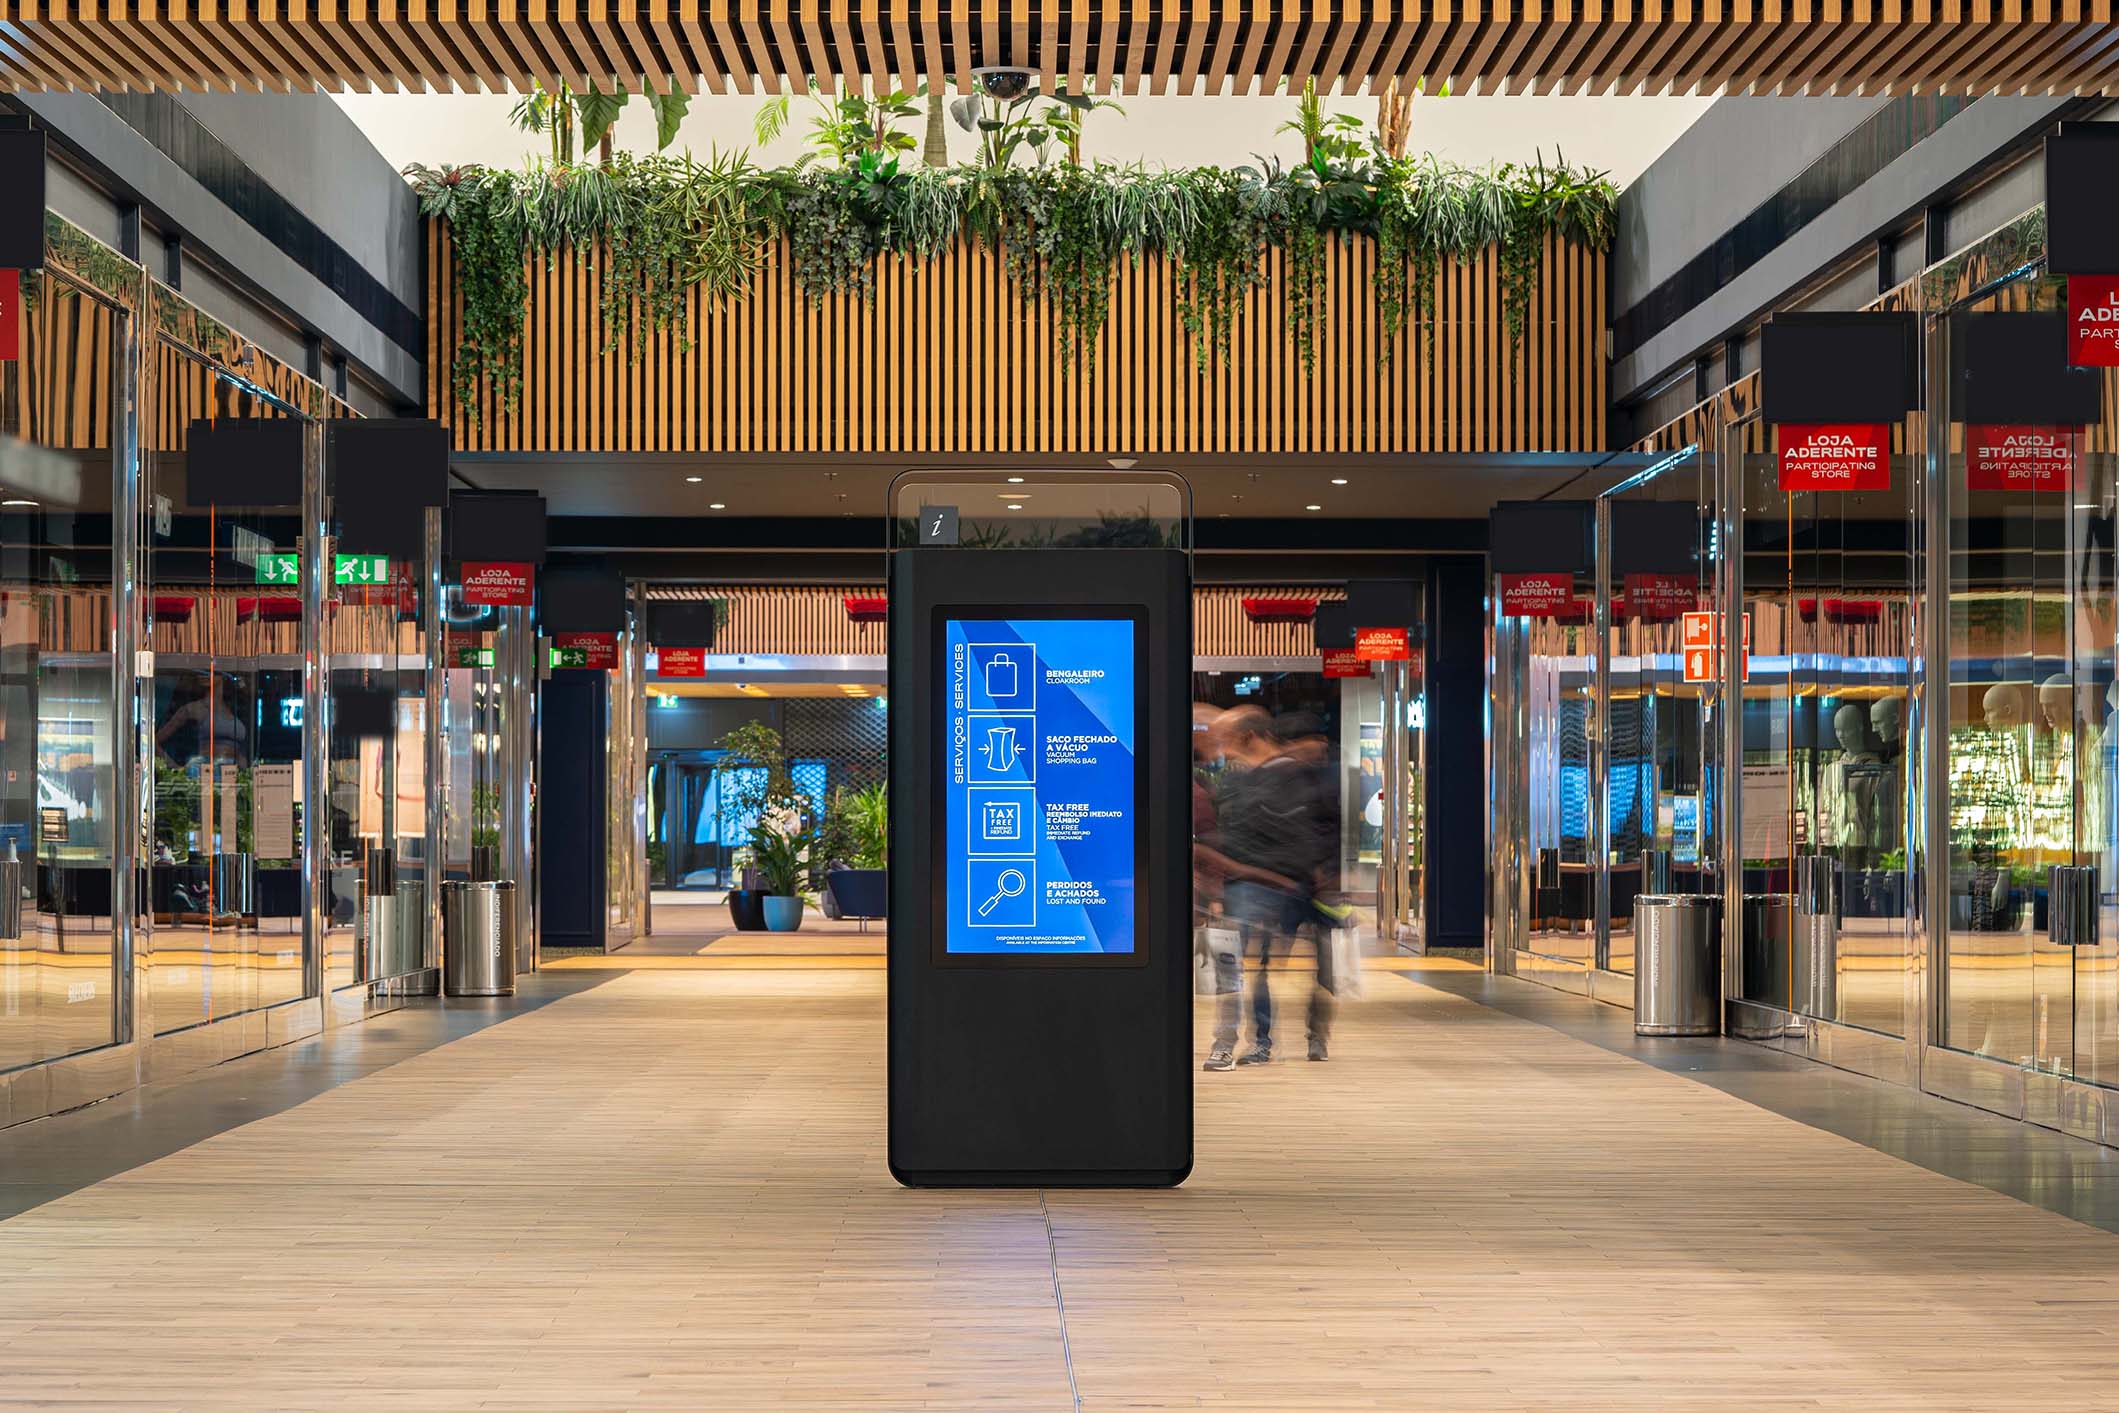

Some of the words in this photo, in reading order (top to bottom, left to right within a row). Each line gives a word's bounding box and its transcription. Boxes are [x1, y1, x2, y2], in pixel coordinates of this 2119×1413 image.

[1807, 435, 1854, 446] LOJA
[1784, 447, 1878, 458] ADERENTE
[1785, 462, 1876, 470] PARTICIPATING
[1811, 470, 1850, 478] STORE
[931, 514, 943, 536] i
[480, 569, 511, 577] LOJA
[466, 577, 526, 586] ADERENTE
[1520, 580, 1550, 588] LOJA
[1506, 588, 1566, 596] ADERENTE
[1046, 670, 1105, 678] BENGALEIRO
[1046, 735, 1071, 743] SACO
[1073, 735, 1117, 743] FECHADO
[954, 716, 966, 784] SERVIÇOS
[1055, 743, 1088, 752] VÁCUO
[1046, 803, 1064, 811] TAX
[1066, 803, 1089, 811] FREE
[989, 808, 1014, 819] TAX
[1046, 881, 1092, 889] PERDIDOS
